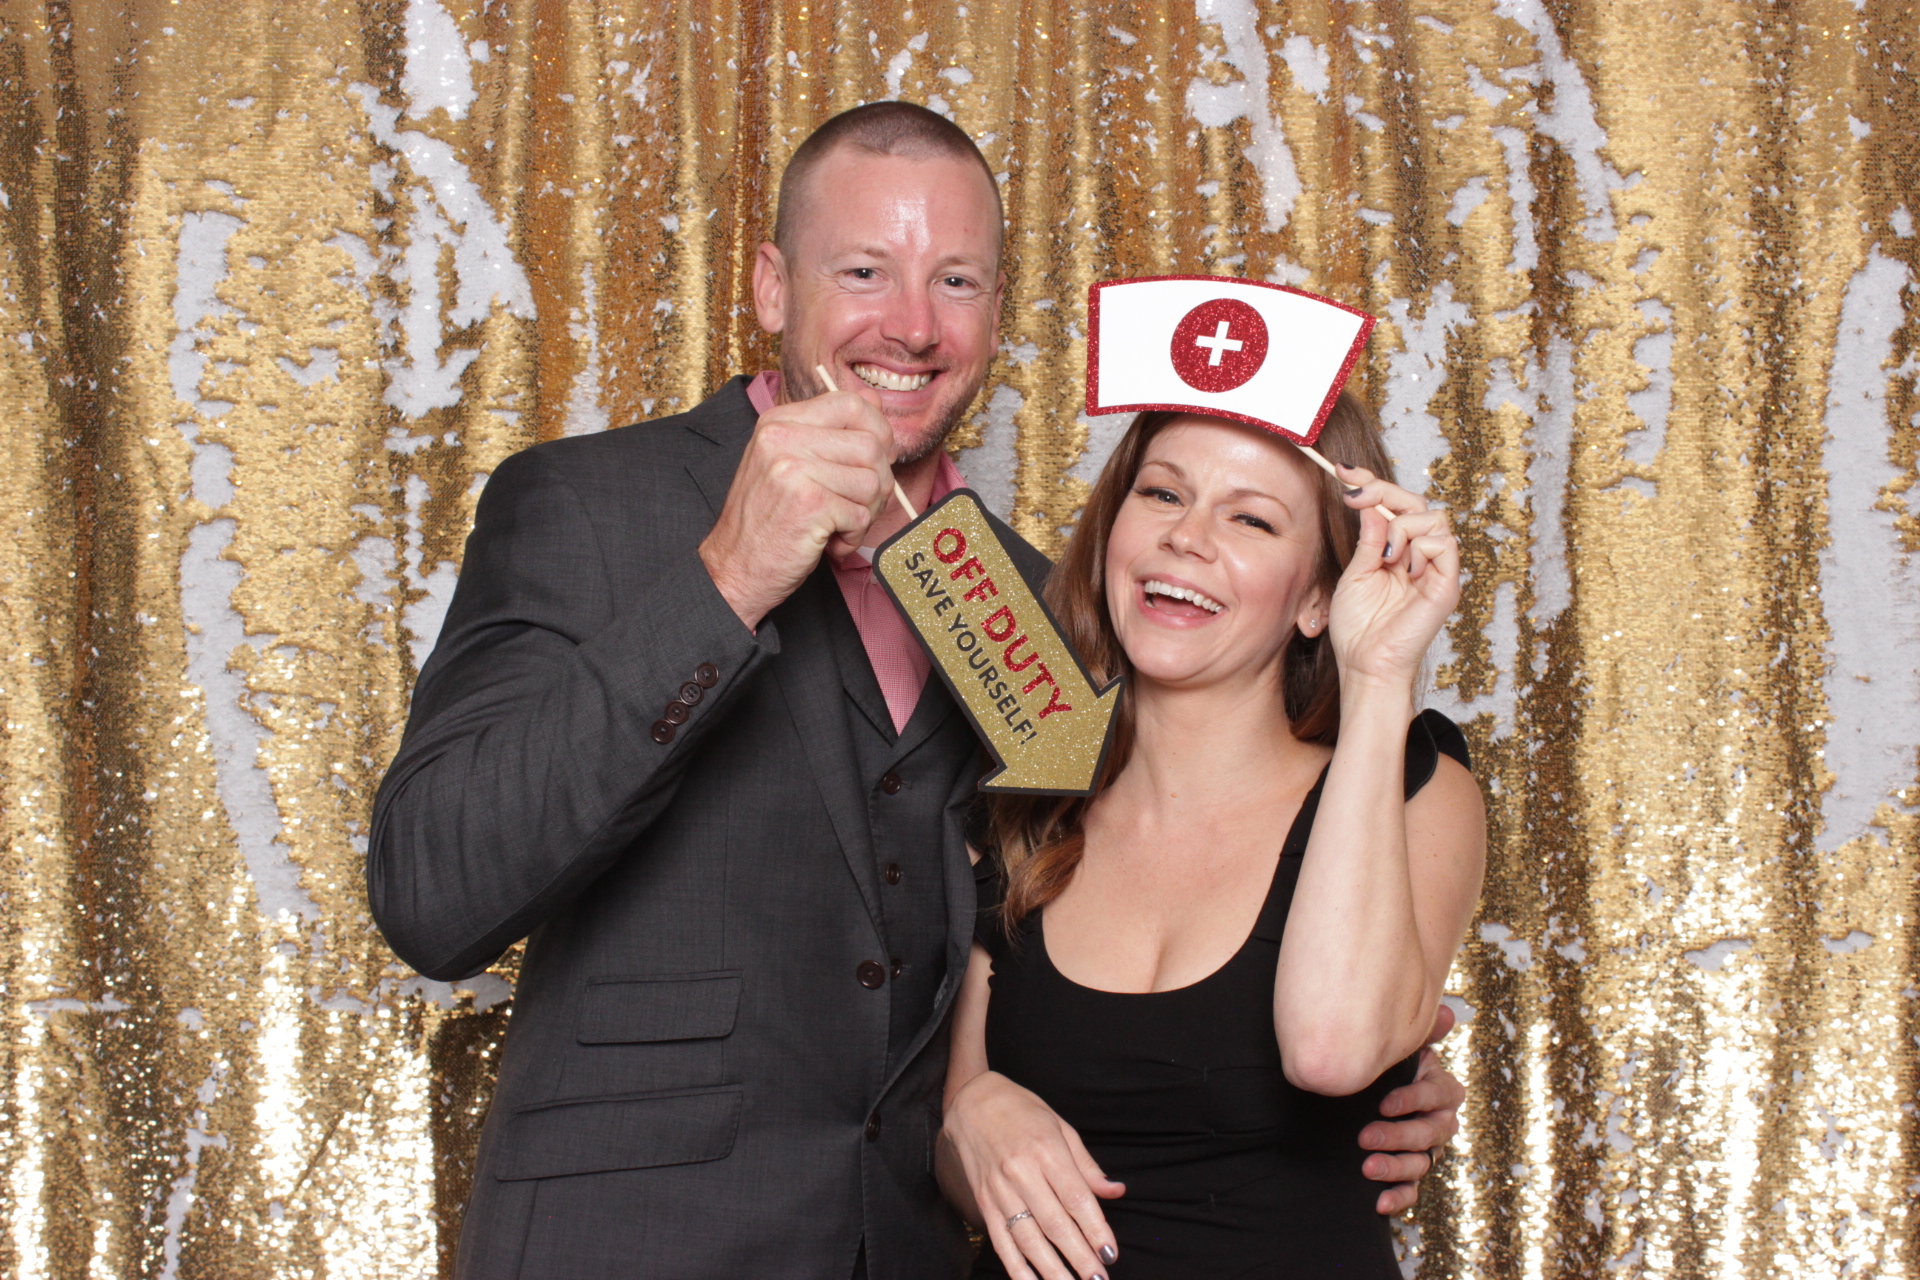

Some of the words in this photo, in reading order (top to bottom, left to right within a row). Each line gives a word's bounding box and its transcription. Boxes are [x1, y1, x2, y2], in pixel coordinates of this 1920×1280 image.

[905, 551, 955, 617] SAVE
[947, 612, 1038, 746] YOURSELF!
[933, 527, 999, 602] OFF
[980, 604, 1073, 720] DUTY
